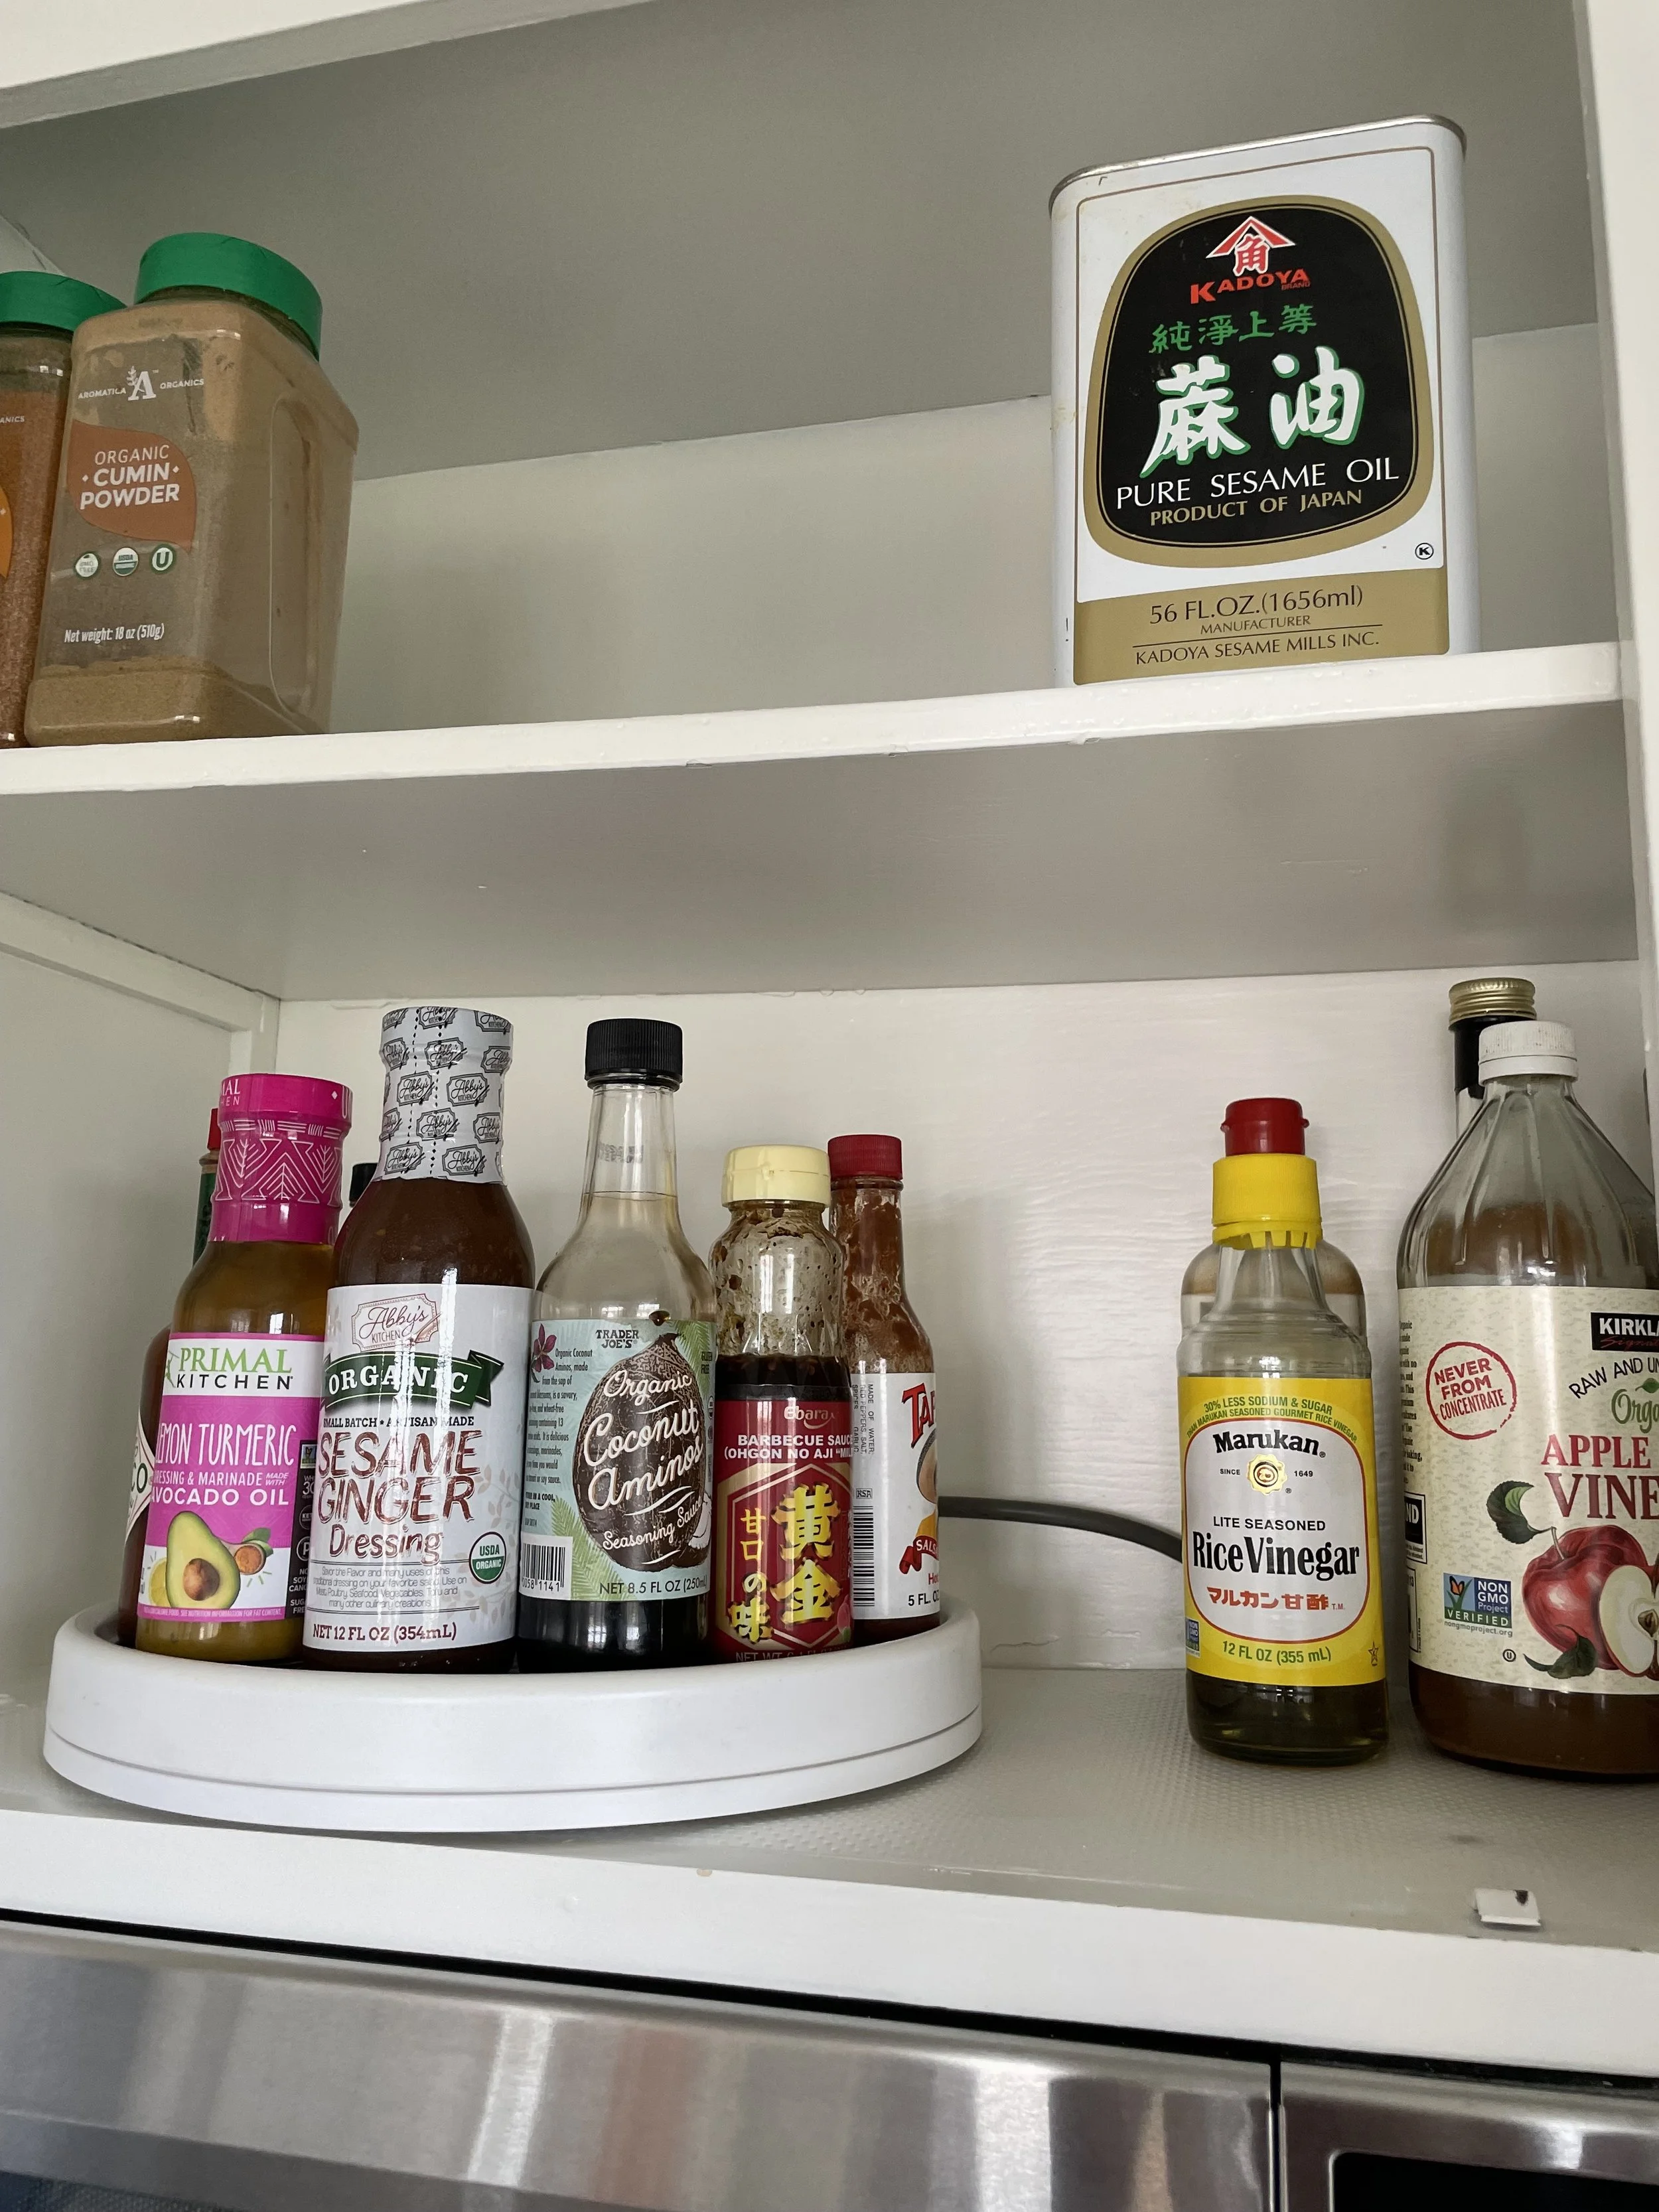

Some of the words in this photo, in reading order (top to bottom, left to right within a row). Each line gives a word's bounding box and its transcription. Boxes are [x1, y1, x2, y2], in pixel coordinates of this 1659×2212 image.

[1190, 269, 1311, 304] KADOYA
[1281, 281, 1311, 291] BRAND
[78, 388, 127, 399] AROMATICA
[160, 378, 204, 390] ORGANICS
[95, 445, 169, 465] ORGANIC
[94, 463, 170, 486] CUMIN
[1117, 479, 1190, 509] PURE
[1210, 463, 1326, 498] SESAME
[1346, 457, 1399, 482] OIL
[80, 484, 180, 510] POWDER
[1150, 500, 1248, 526] PRODUCT
[1260, 496, 1288, 513] OF
[1300, 490, 1362, 512] JAPAN
[1149, 604, 1177, 624] 56
[64, 629, 80, 642] Net
[82, 627, 113, 644] weight:
[115, 627, 124, 640] 18
[126, 628, 135, 638] oz
[137, 623, 165, 640] (510g)
[1200, 615, 1311, 634] MANUFACTURER
[1136, 646, 1208, 665] KADOYA
[1215, 638, 1280, 658] SESAME
[1287, 634, 1336, 652] MILLS
[1342, 631, 1380, 648] INC.
[451, 1079, 484, 1099] Abby's
[447, 1150, 479, 1171] Abby's
[359, 1305, 428, 1339] Abby's
[372, 1329, 401, 1343] KITCHEN
[595, 1329, 639, 1339] TRADER
[601, 1339, 633, 1349] JOE'S
[179, 1347, 292, 1373] PRIMAL
[555, 1348, 572, 1359] Organic
[573, 1348, 593, 1357] Coconut
[555, 1362, 573, 1372] Aminos,
[574, 1361, 589, 1371] made
[1434, 1358, 1492, 1385] NEVER
[177, 1374, 292, 1390] KITCHEN
[328, 1364, 469, 1396] ORGANIC
[603, 1369, 692, 1406] Organic
[1441, 1374, 1492, 1400] FROM
[1569, 1366, 1607, 1399] RAW
[1613, 1357, 1643, 1379] AND
[561, 1392, 578, 1401] savory,
[1204, 1399, 1221, 1413] 30%
[1223, 1397, 1246, 1407] LESS
[1248, 1396, 1288, 1406] SODIUM
[1291, 1397, 1299, 1407] &
[1301, 1399, 1333, 1415] SUGAR
[1439, 1389, 1507, 1421] CONCENTRATE
[324, 1417, 343, 1427] SMALL
[345, 1417, 377, 1427] BATCH
[558, 1418, 563, 1427] 13
[868, 1410, 874, 1420] OF
[1197, 1410, 1228, 1427] MARUKAN
[1229, 1407, 1271, 1417] SEASONED
[1273, 1408, 1314, 1420] GOURMET
[1315, 1413, 1333, 1426] RICE
[550, 1430, 569, 1441] delicious
[584, 1398, 699, 1467] Coconut
[738, 1435, 824, 1446] BARBECUE
[198, 1424, 297, 1467] TURMERIC
[724, 1446, 782, 1459] (OHGON
[788, 1448, 810, 1459] NO
[814, 1448, 833, 1459] AJI
[1212, 1430, 1319, 1456] Marukan
[1540, 1434, 1652, 1469] APPLE
[318, 1429, 483, 1479] SESAME
[187, 1471, 194, 1485] &
[198, 1471, 263, 1487] MARINADE
[588, 1436, 703, 1510] Aminos
[151, 1487, 240, 1506] AVOCADO
[250, 1488, 289, 1506] OIL
[318, 1475, 476, 1524] GINGER
[541, 1493, 555, 1502] COOL,
[677, 1495, 703, 1528] Sauce
[1213, 1516, 1240, 1528] LITE
[1245, 1518, 1326, 1531] SEASONED
[329, 1523, 445, 1566] Dressing
[603, 1524, 675, 1550] Seasoning
[479, 1544, 500, 1556] USDA
[1192, 1531, 1243, 1572] Rice
[1244, 1536, 1360, 1582] Vinegar
[336, 1567, 346, 1576] the
[347, 1567, 366, 1576] Flavor
[368, 1567, 382, 1576] and
[475, 1558, 502, 1570] ORGANIC
[370, 1580, 386, 1589] your
[388, 1578, 418, 1587] favorite
[444, 1586, 459, 1595] and
[600, 1582, 624, 1594] NET
[628, 1582, 646, 1594] 8.5
[651, 1582, 662, 1593] FL
[665, 1580, 681, 1592] OZ
[1478, 1581, 1508, 1593] NON
[908, 1594, 915, 1606] 5
[918, 1593, 930, 1605] FL.
[1478, 1592, 1509, 1604] GMO
[1478, 1601, 1509, 1614] Project
[1448, 1609, 1509, 1627] VERIFIED
[313, 1623, 332, 1639] NET
[334, 1625, 346, 1639] 12
[348, 1626, 365, 1641] FL
[368, 1626, 390, 1641] OZ
[394, 1621, 457, 1644] (354mL)
[1444, 1621, 1513, 1638] nongmoproject.org
[1223, 1641, 1236, 1655] 12
[1239, 1645, 1252, 1659] FL
[1256, 1648, 1272, 1662] OZ
[1277, 1650, 1304, 1666] (355
[1309, 1646, 1331, 1662] mL)
